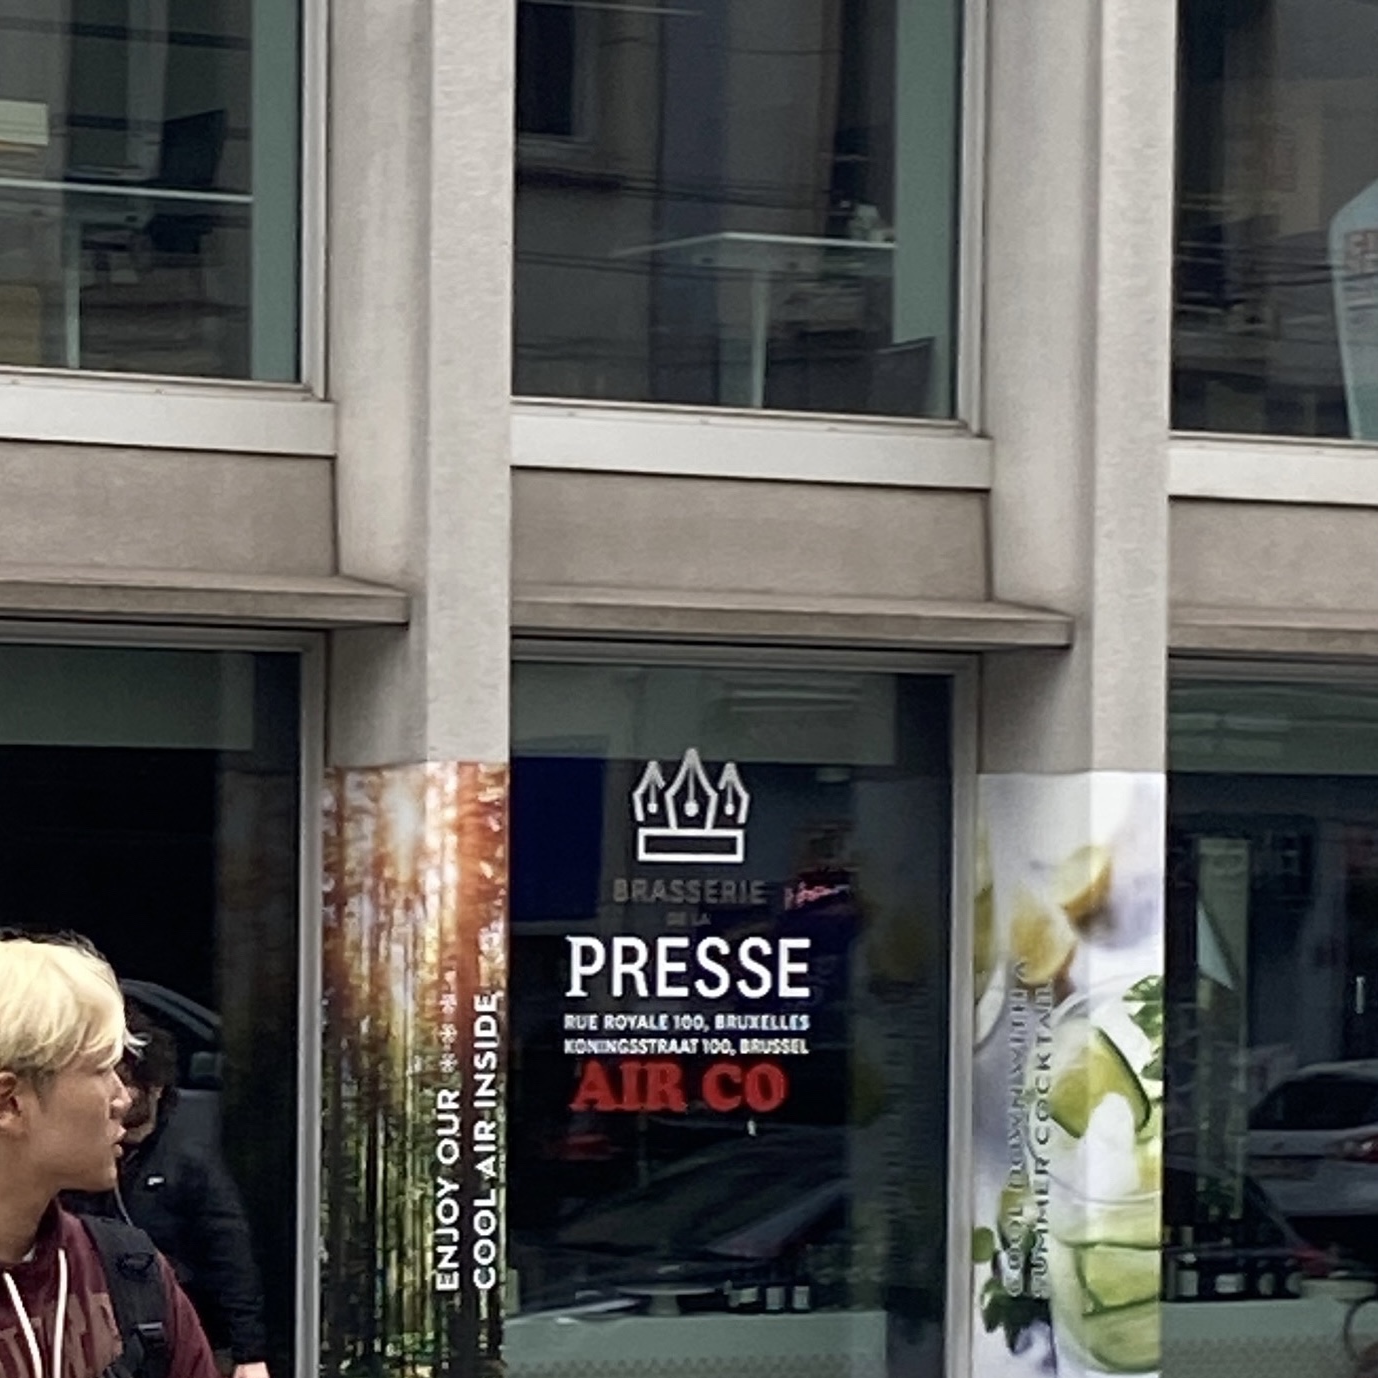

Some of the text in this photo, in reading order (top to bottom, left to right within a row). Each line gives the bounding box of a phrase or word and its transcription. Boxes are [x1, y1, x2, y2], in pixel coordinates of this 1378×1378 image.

[613, 879, 767, 904] BRASSERIE
[565, 936, 811, 998] PRESSE
[564, 1014, 810, 1032] RUE ROYALE 100, BRUXELLES
[564, 1038, 809, 1056] KONINGSSTRAAT 100, BRUSSEL
[570, 1060, 785, 1112] AIR CO
[473, 1119, 497, 1181] AIR
[1008, 1087, 1027, 1190] DOWN
[436, 1088, 460, 1291] ENJOY OUR
[473, 1188, 497, 1290] COOL
[1009, 1203, 1024, 1298] COOL
[1031, 1158, 1051, 1298] SUMMER
